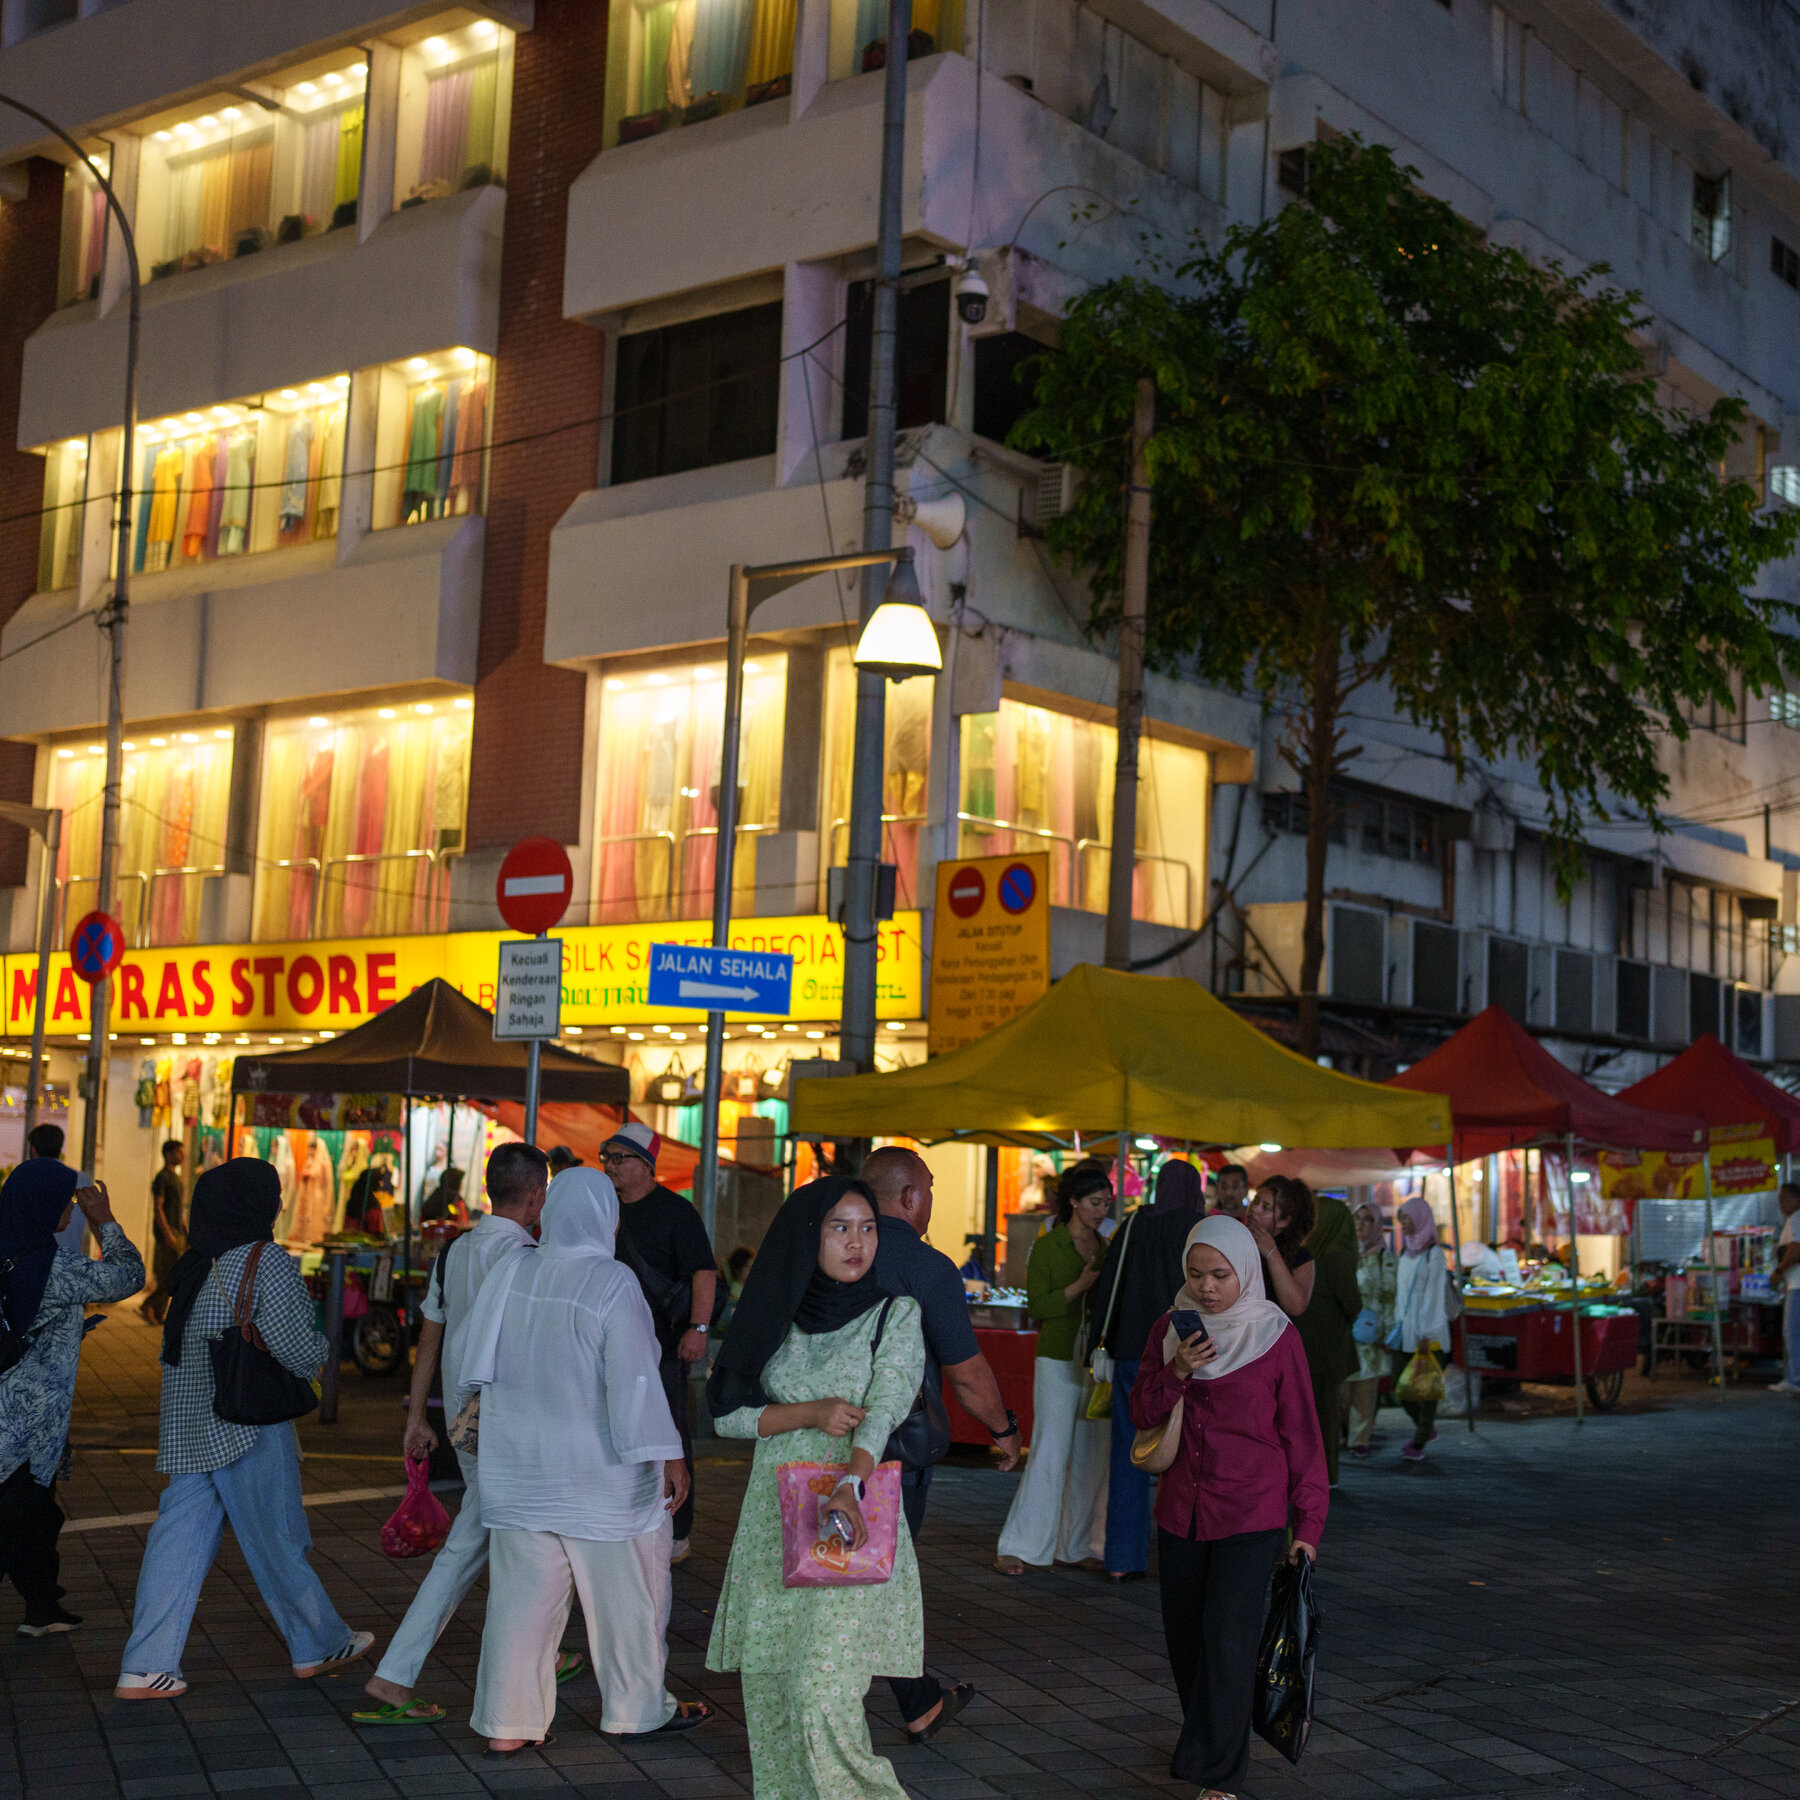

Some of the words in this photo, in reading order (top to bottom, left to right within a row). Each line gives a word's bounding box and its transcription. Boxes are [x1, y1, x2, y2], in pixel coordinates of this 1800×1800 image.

[511, 952, 548, 966] Kecuali
[560, 940, 615, 973] SILK
[656, 953, 713, 975] JALAN
[719, 957, 788, 981] SEHALA
[10, 960, 215, 1021] MARAS
[231, 953, 397, 1018] STORE
[502, 973, 558, 986] Kenderaan
[509, 993, 546, 1008] Ringan
[508, 1012, 544, 1028] Sahaja
